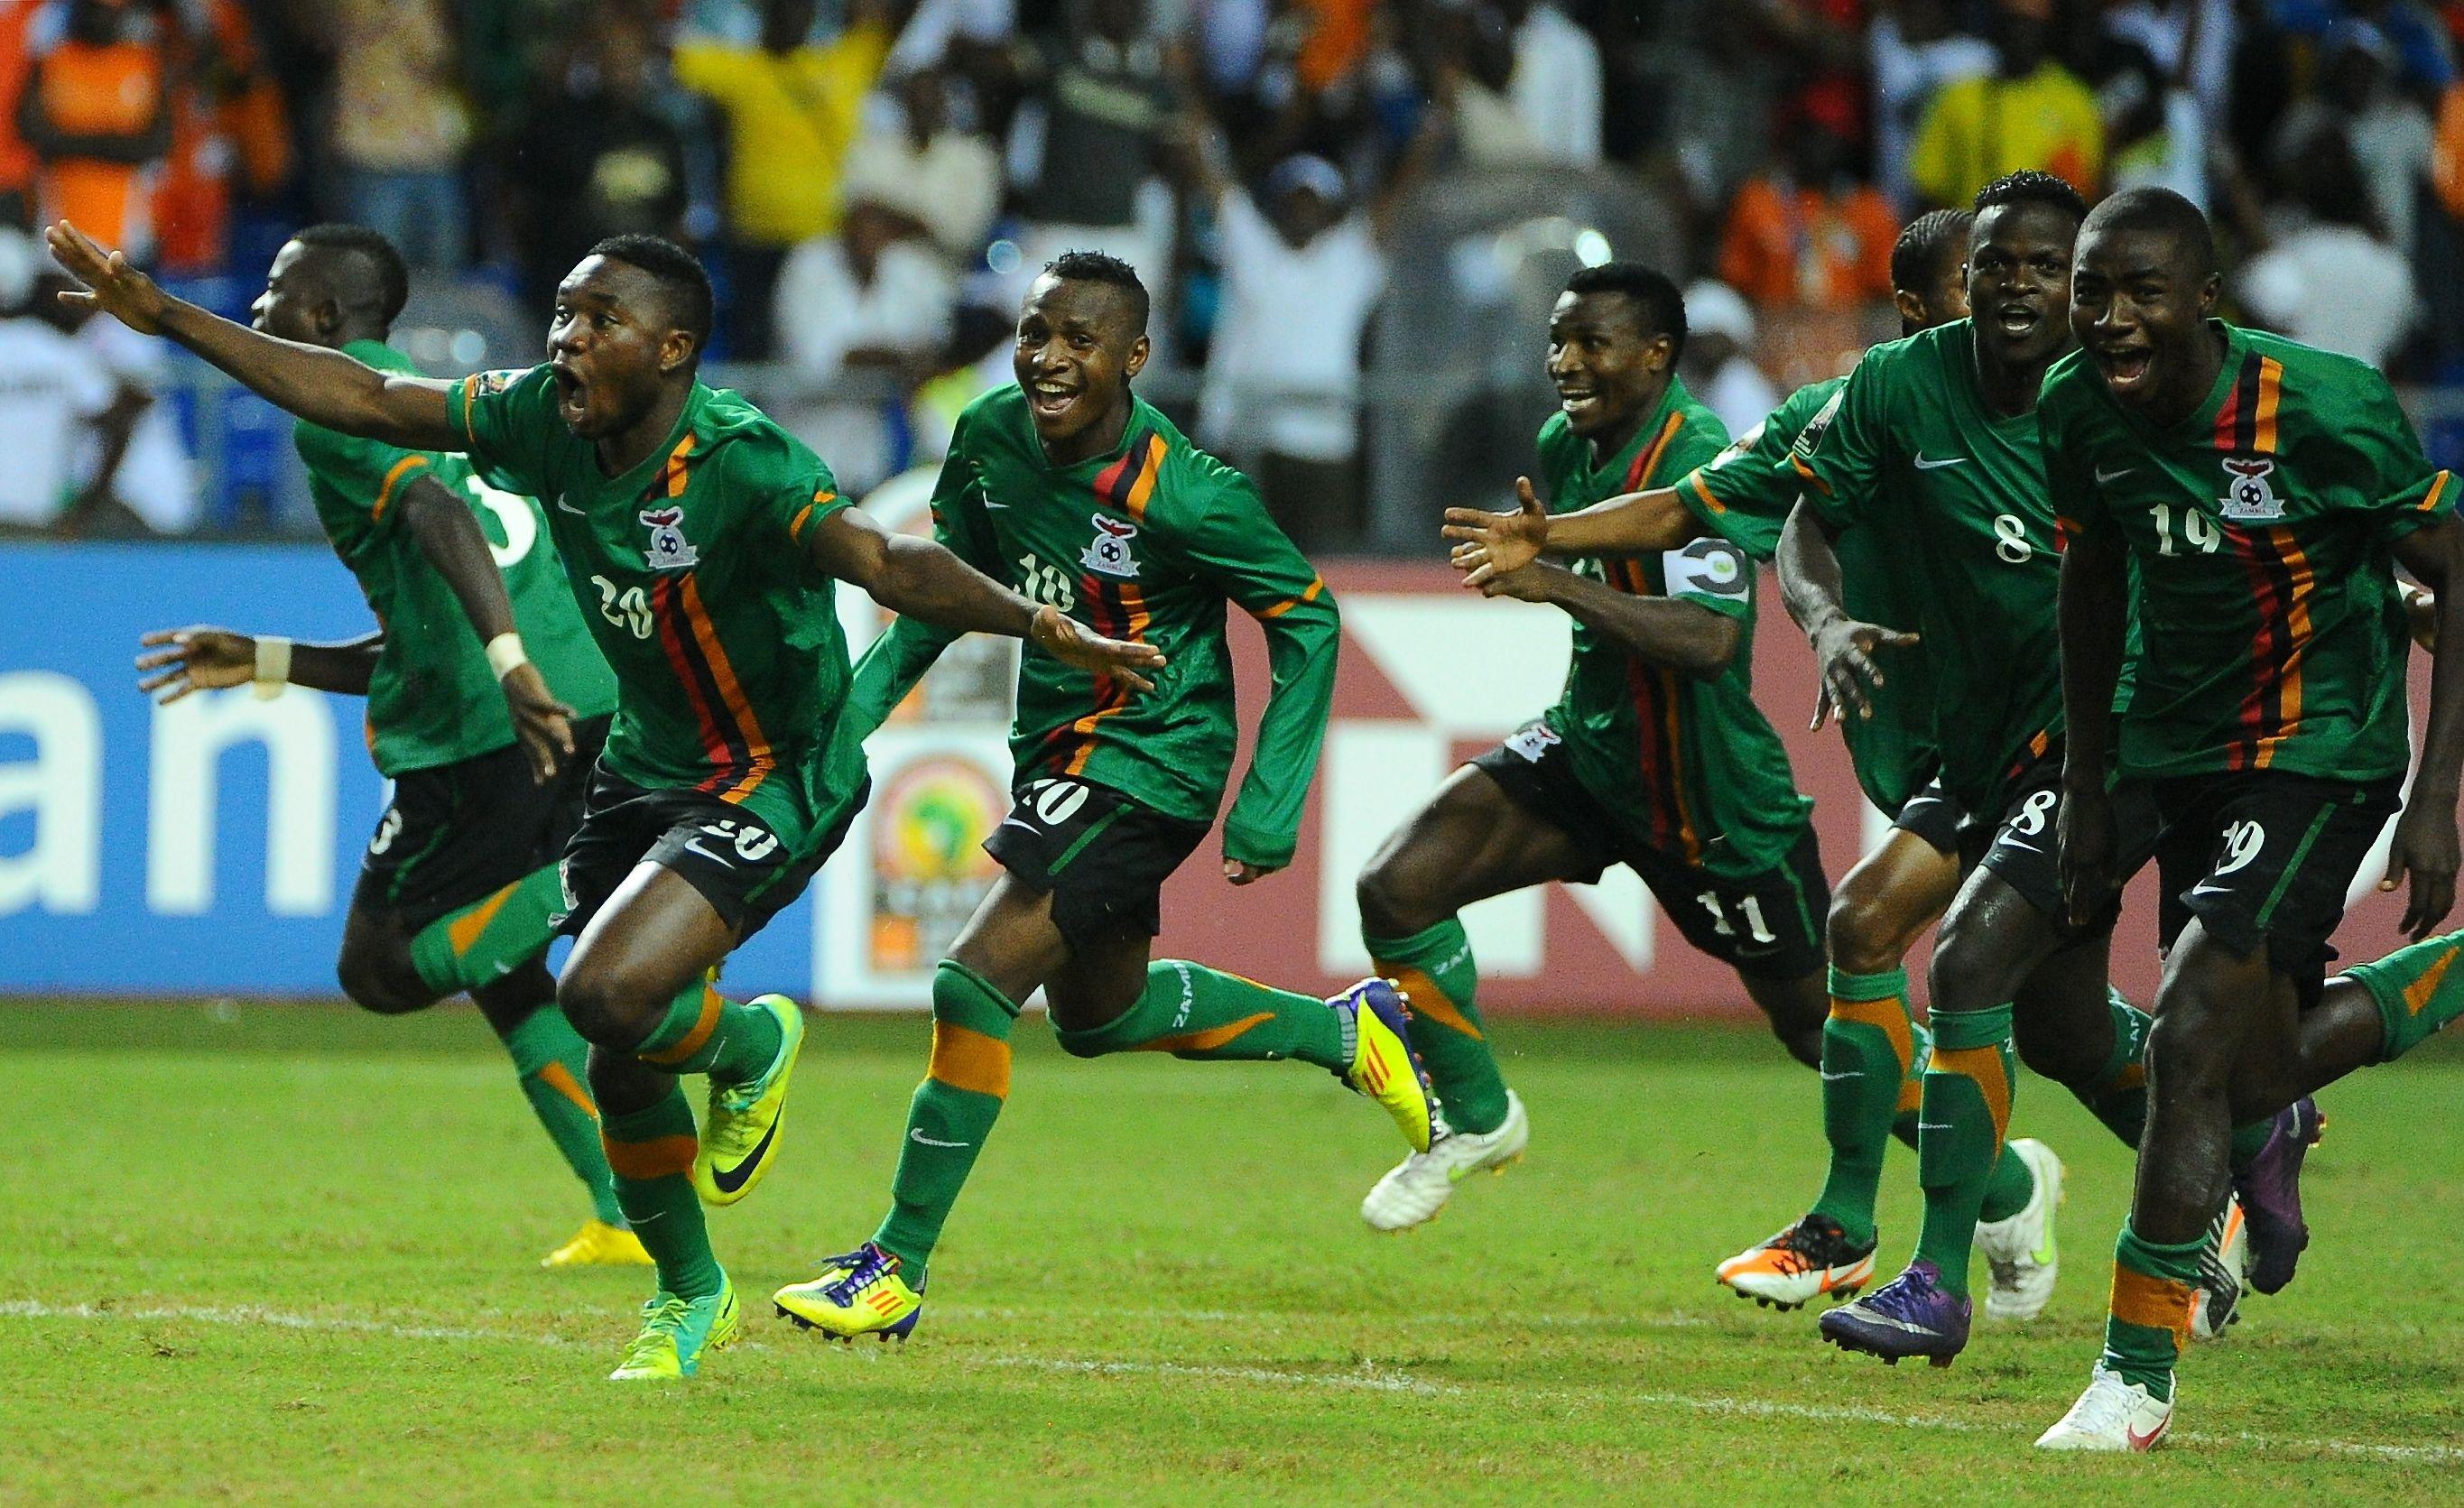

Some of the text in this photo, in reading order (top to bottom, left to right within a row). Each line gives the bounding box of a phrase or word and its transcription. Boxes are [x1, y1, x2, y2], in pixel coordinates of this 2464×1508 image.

[1994, 514, 2032, 563] 8
[2149, 503, 2220, 556] 19
[591, 575, 653, 640] 20
[1013, 553, 1075, 613] 10
[2010, 790, 2057, 836] 8
[2215, 820, 2265, 876] 19
[1697, 891, 1776, 943] 11
